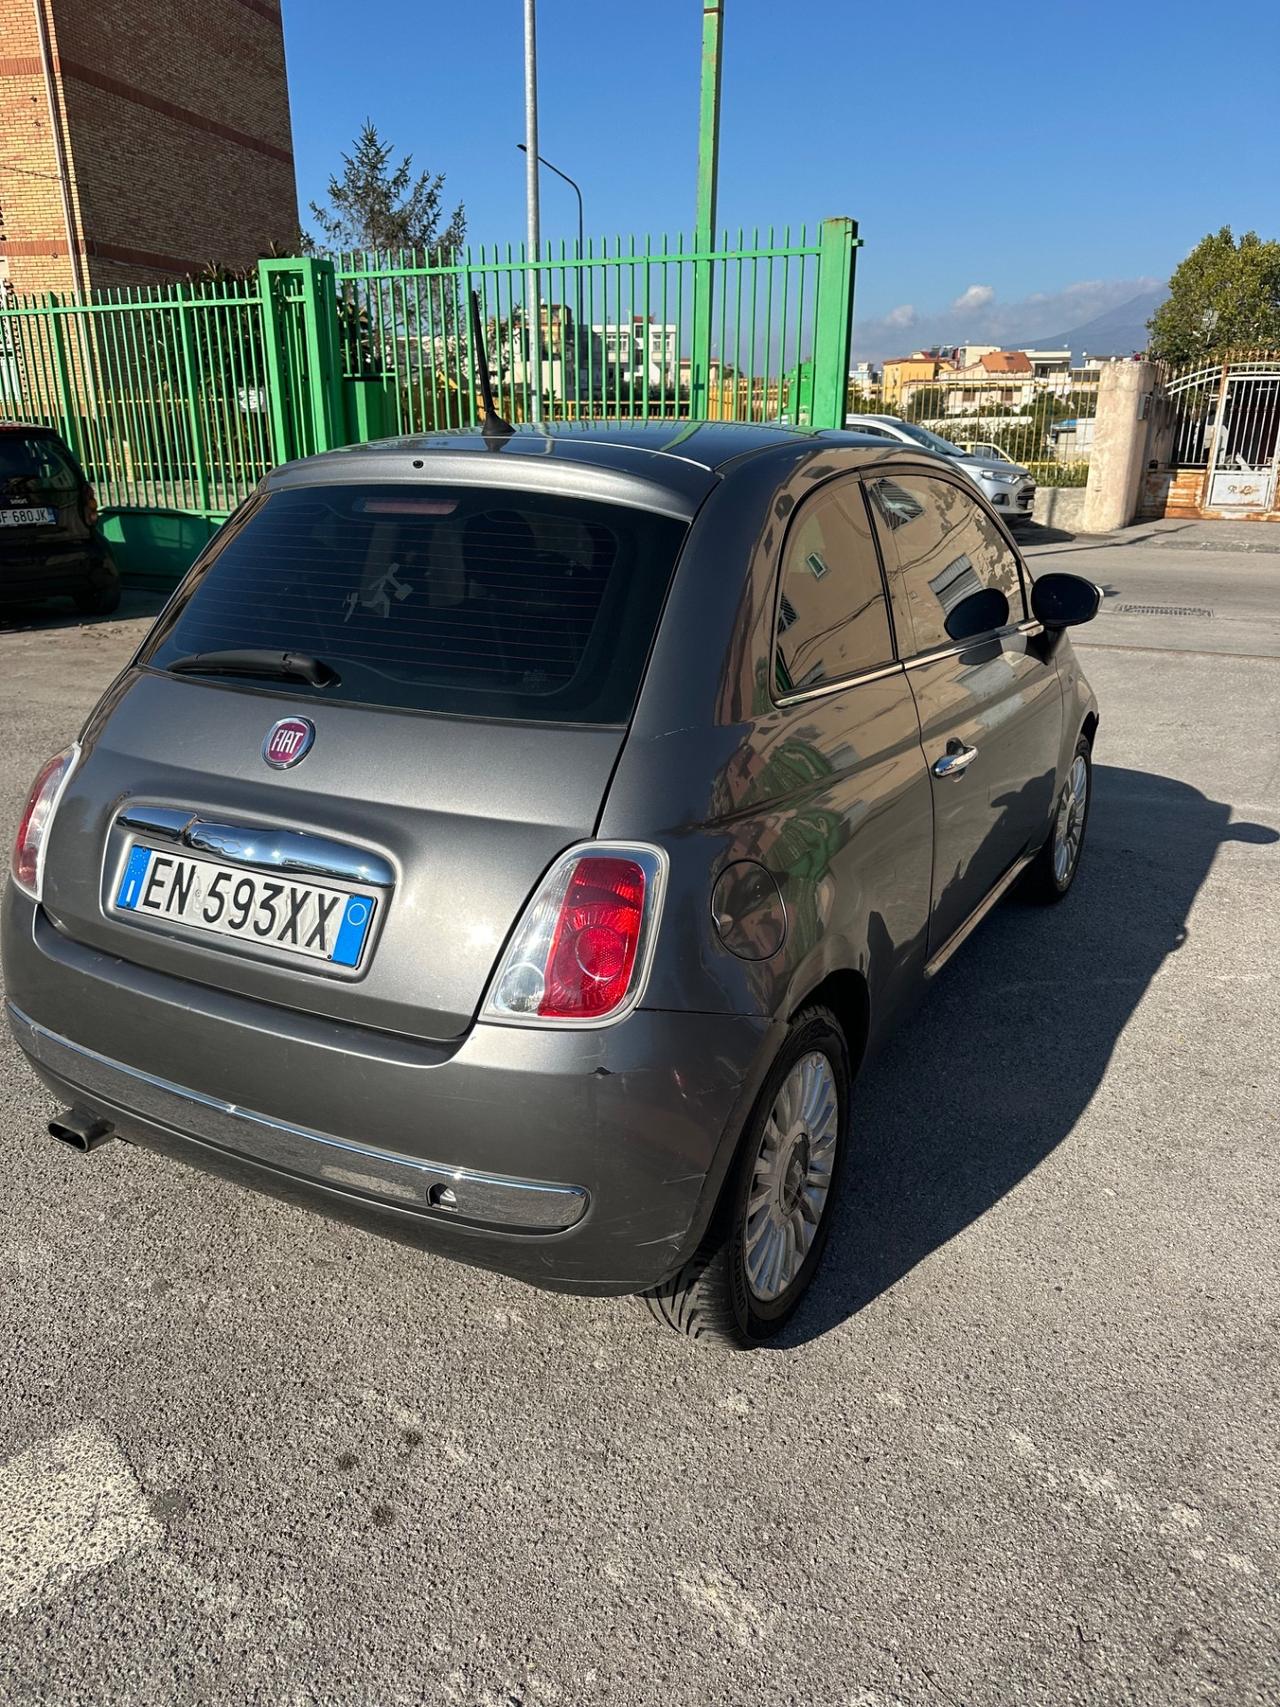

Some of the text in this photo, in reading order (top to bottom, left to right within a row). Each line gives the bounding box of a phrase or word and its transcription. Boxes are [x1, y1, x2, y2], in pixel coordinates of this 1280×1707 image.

[0, 510, 47, 523] F 680JK
[271, 729, 304, 754] FIAT
[142, 856, 197, 916] EN
[202, 872, 340, 951] 593XX
